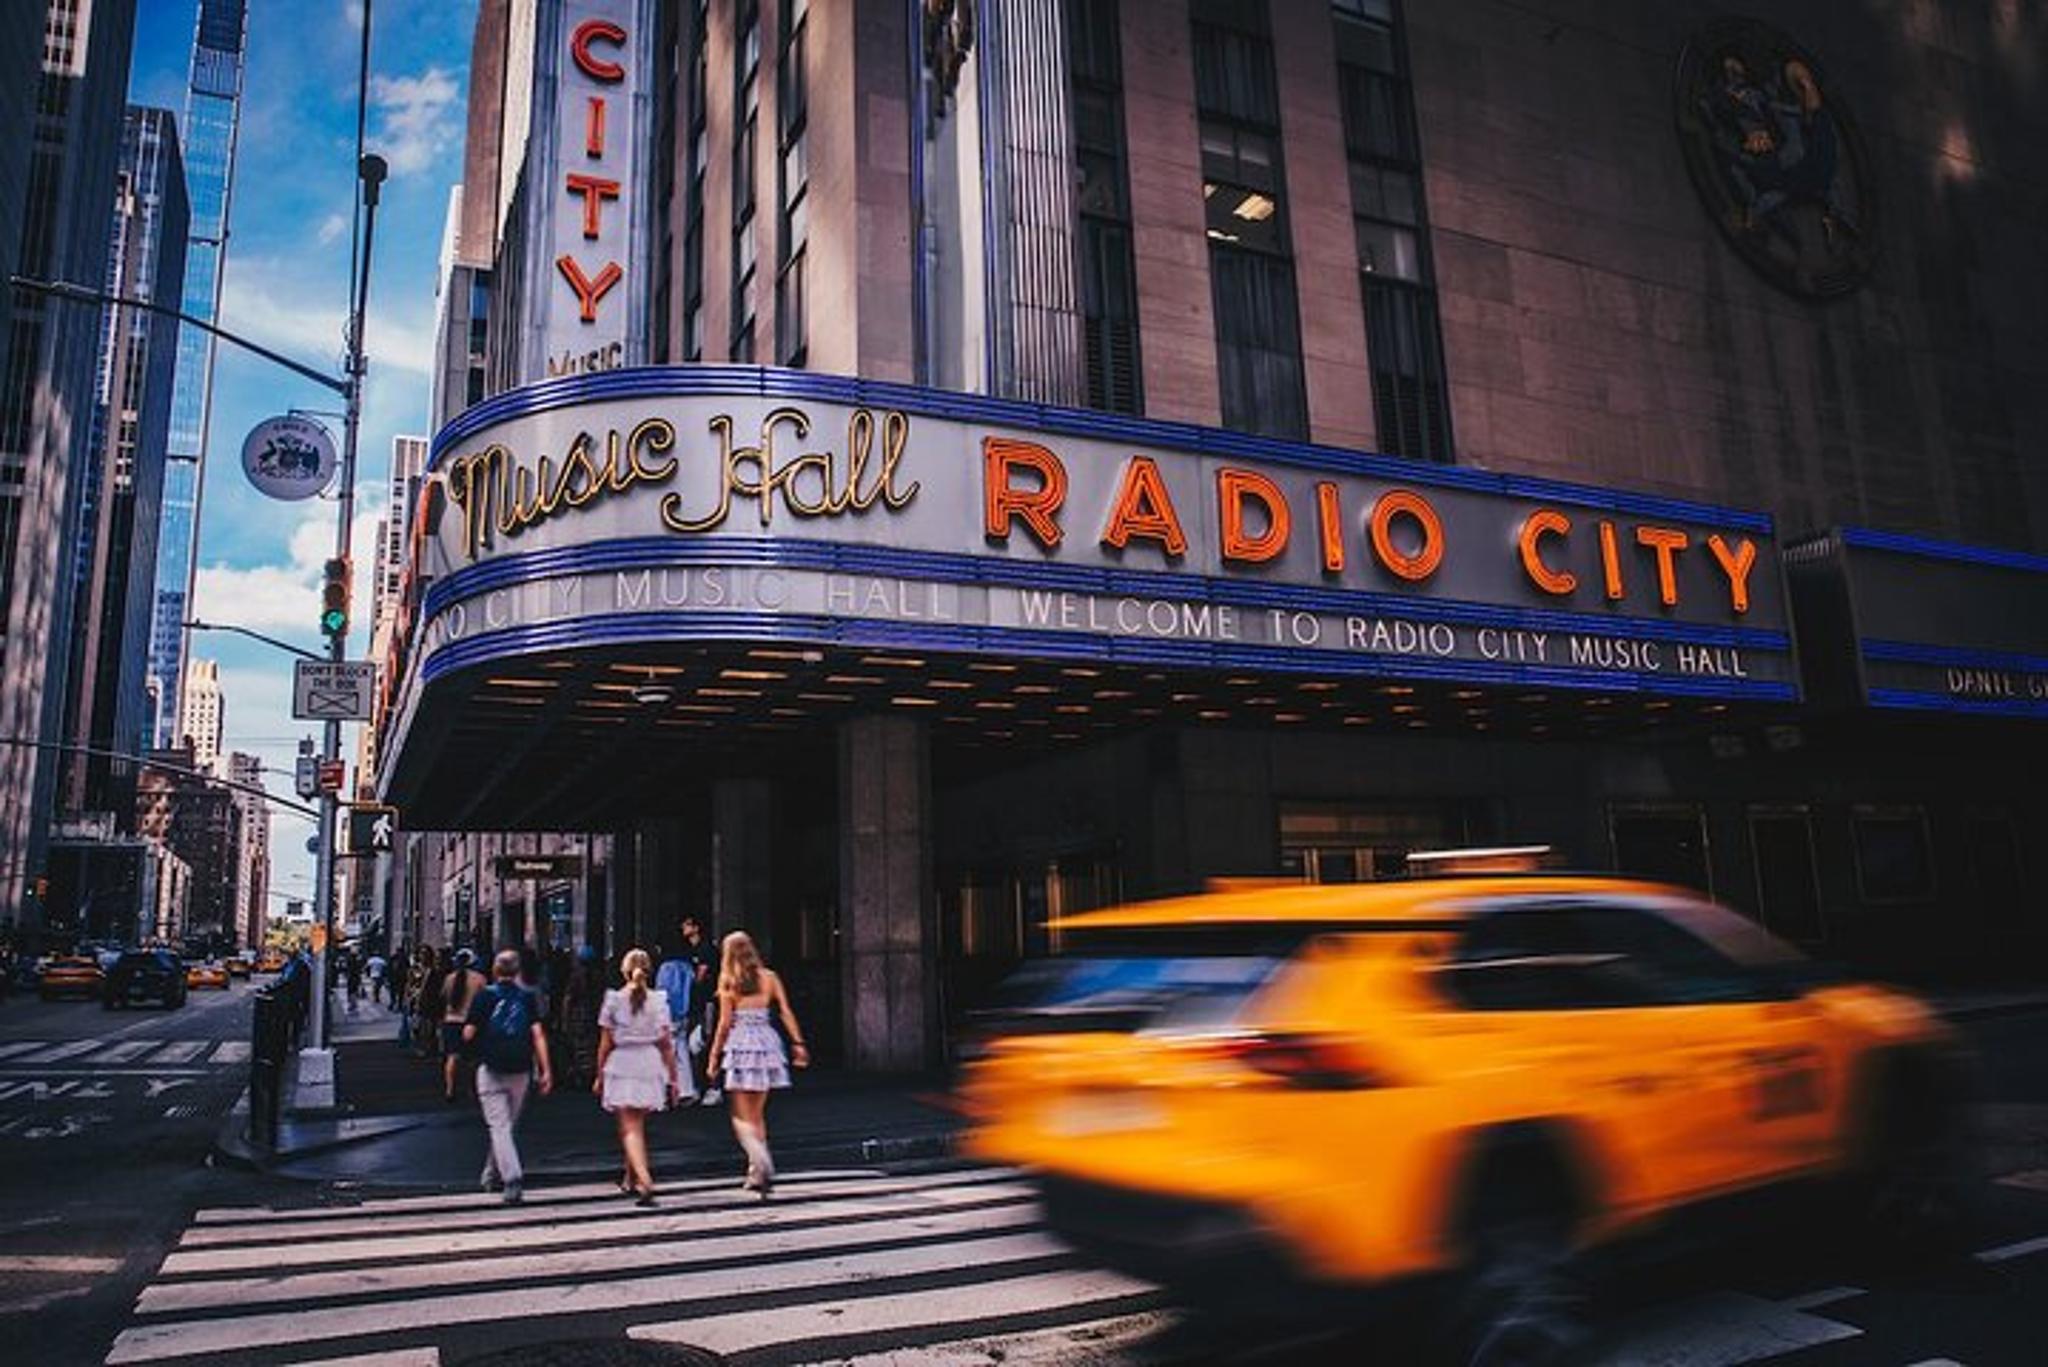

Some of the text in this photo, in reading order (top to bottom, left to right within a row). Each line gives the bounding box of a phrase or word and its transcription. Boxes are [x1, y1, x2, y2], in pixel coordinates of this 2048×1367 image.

[555, 20, 627, 325] CITY
[548, 341, 622, 376] MUSIC
[447, 406, 921, 561] Music Hall
[982, 435, 1758, 614] RADIO CITY
[827, 574, 954, 619] HALL
[1021, 590, 1747, 676] WELCOME TO RADIO CITY MUSIC HALL
